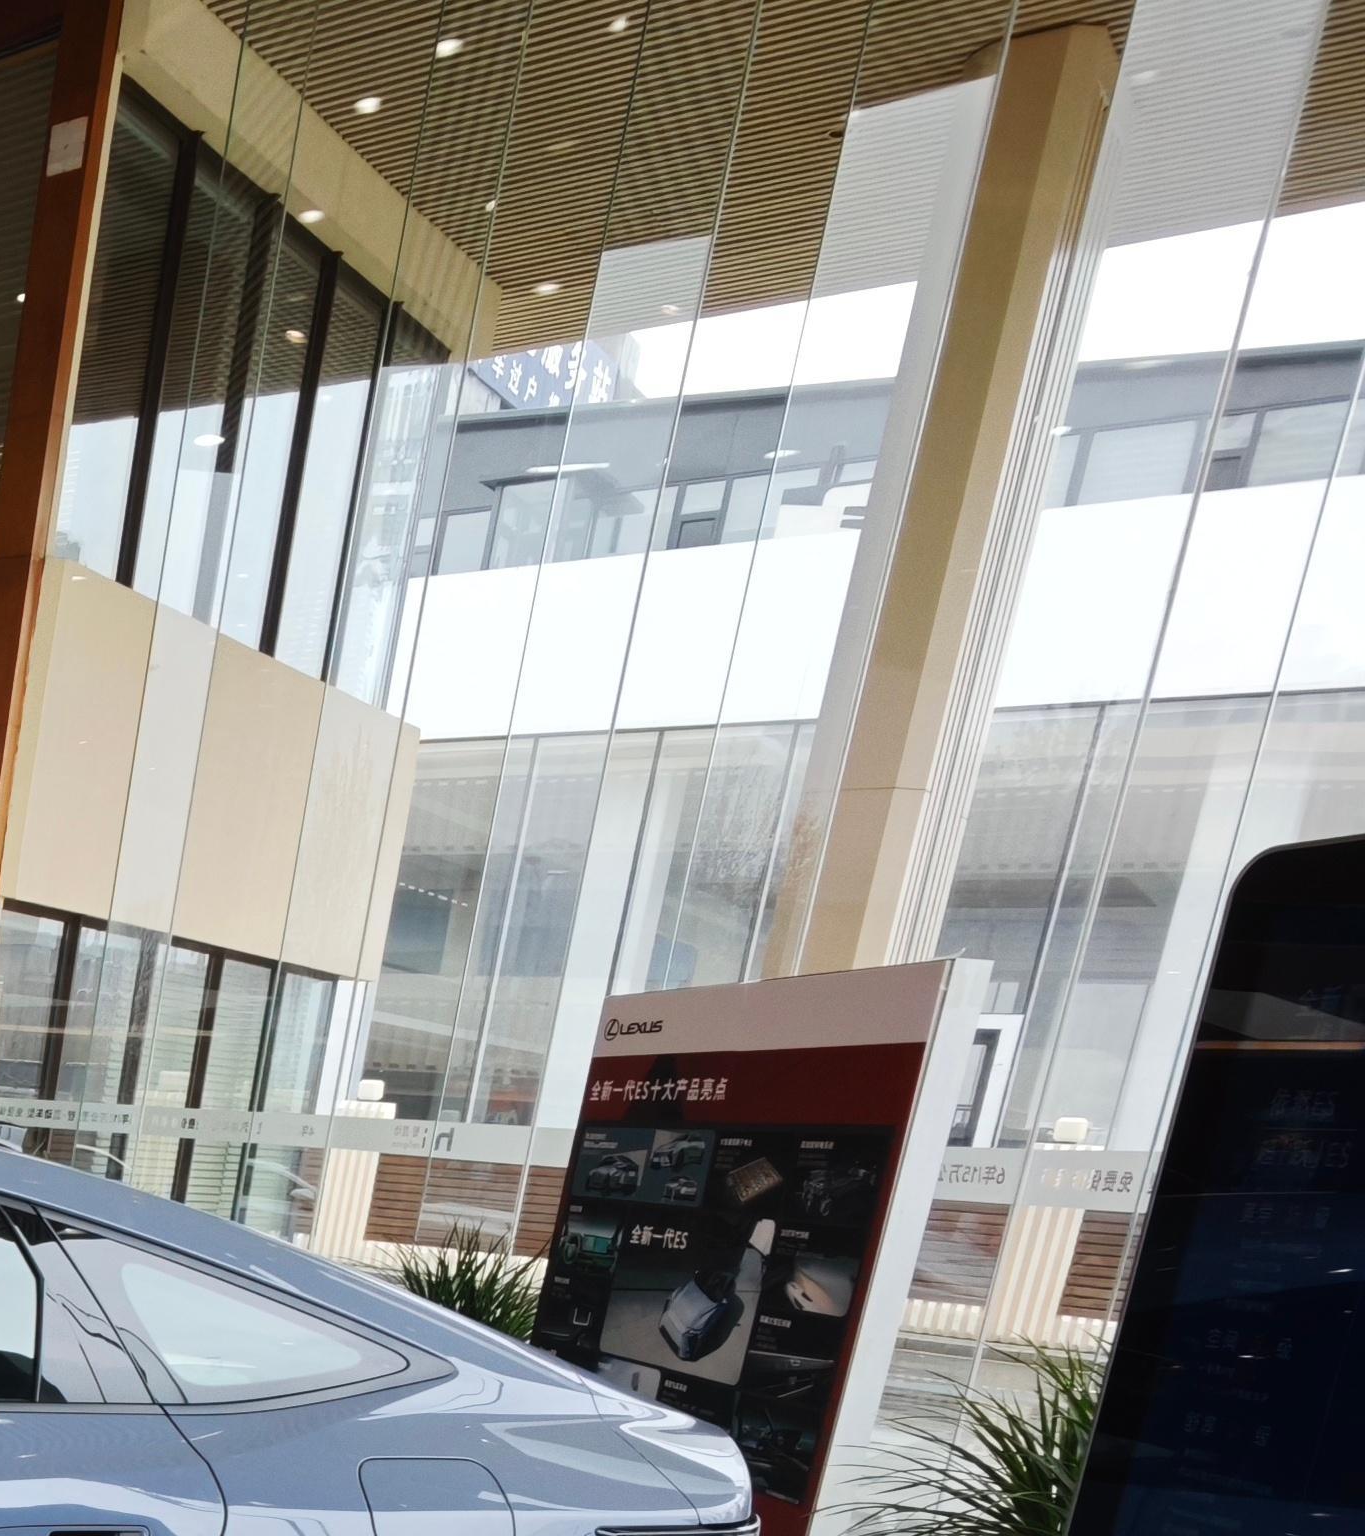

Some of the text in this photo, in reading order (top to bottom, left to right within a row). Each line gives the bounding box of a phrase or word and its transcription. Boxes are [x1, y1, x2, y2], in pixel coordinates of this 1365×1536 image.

[620, 1020, 664, 1035] LEXUS
[590, 1076, 729, 1102] 全新一代ES十大产品亮点
[629, 1225, 690, 1250] 全新一代ES
